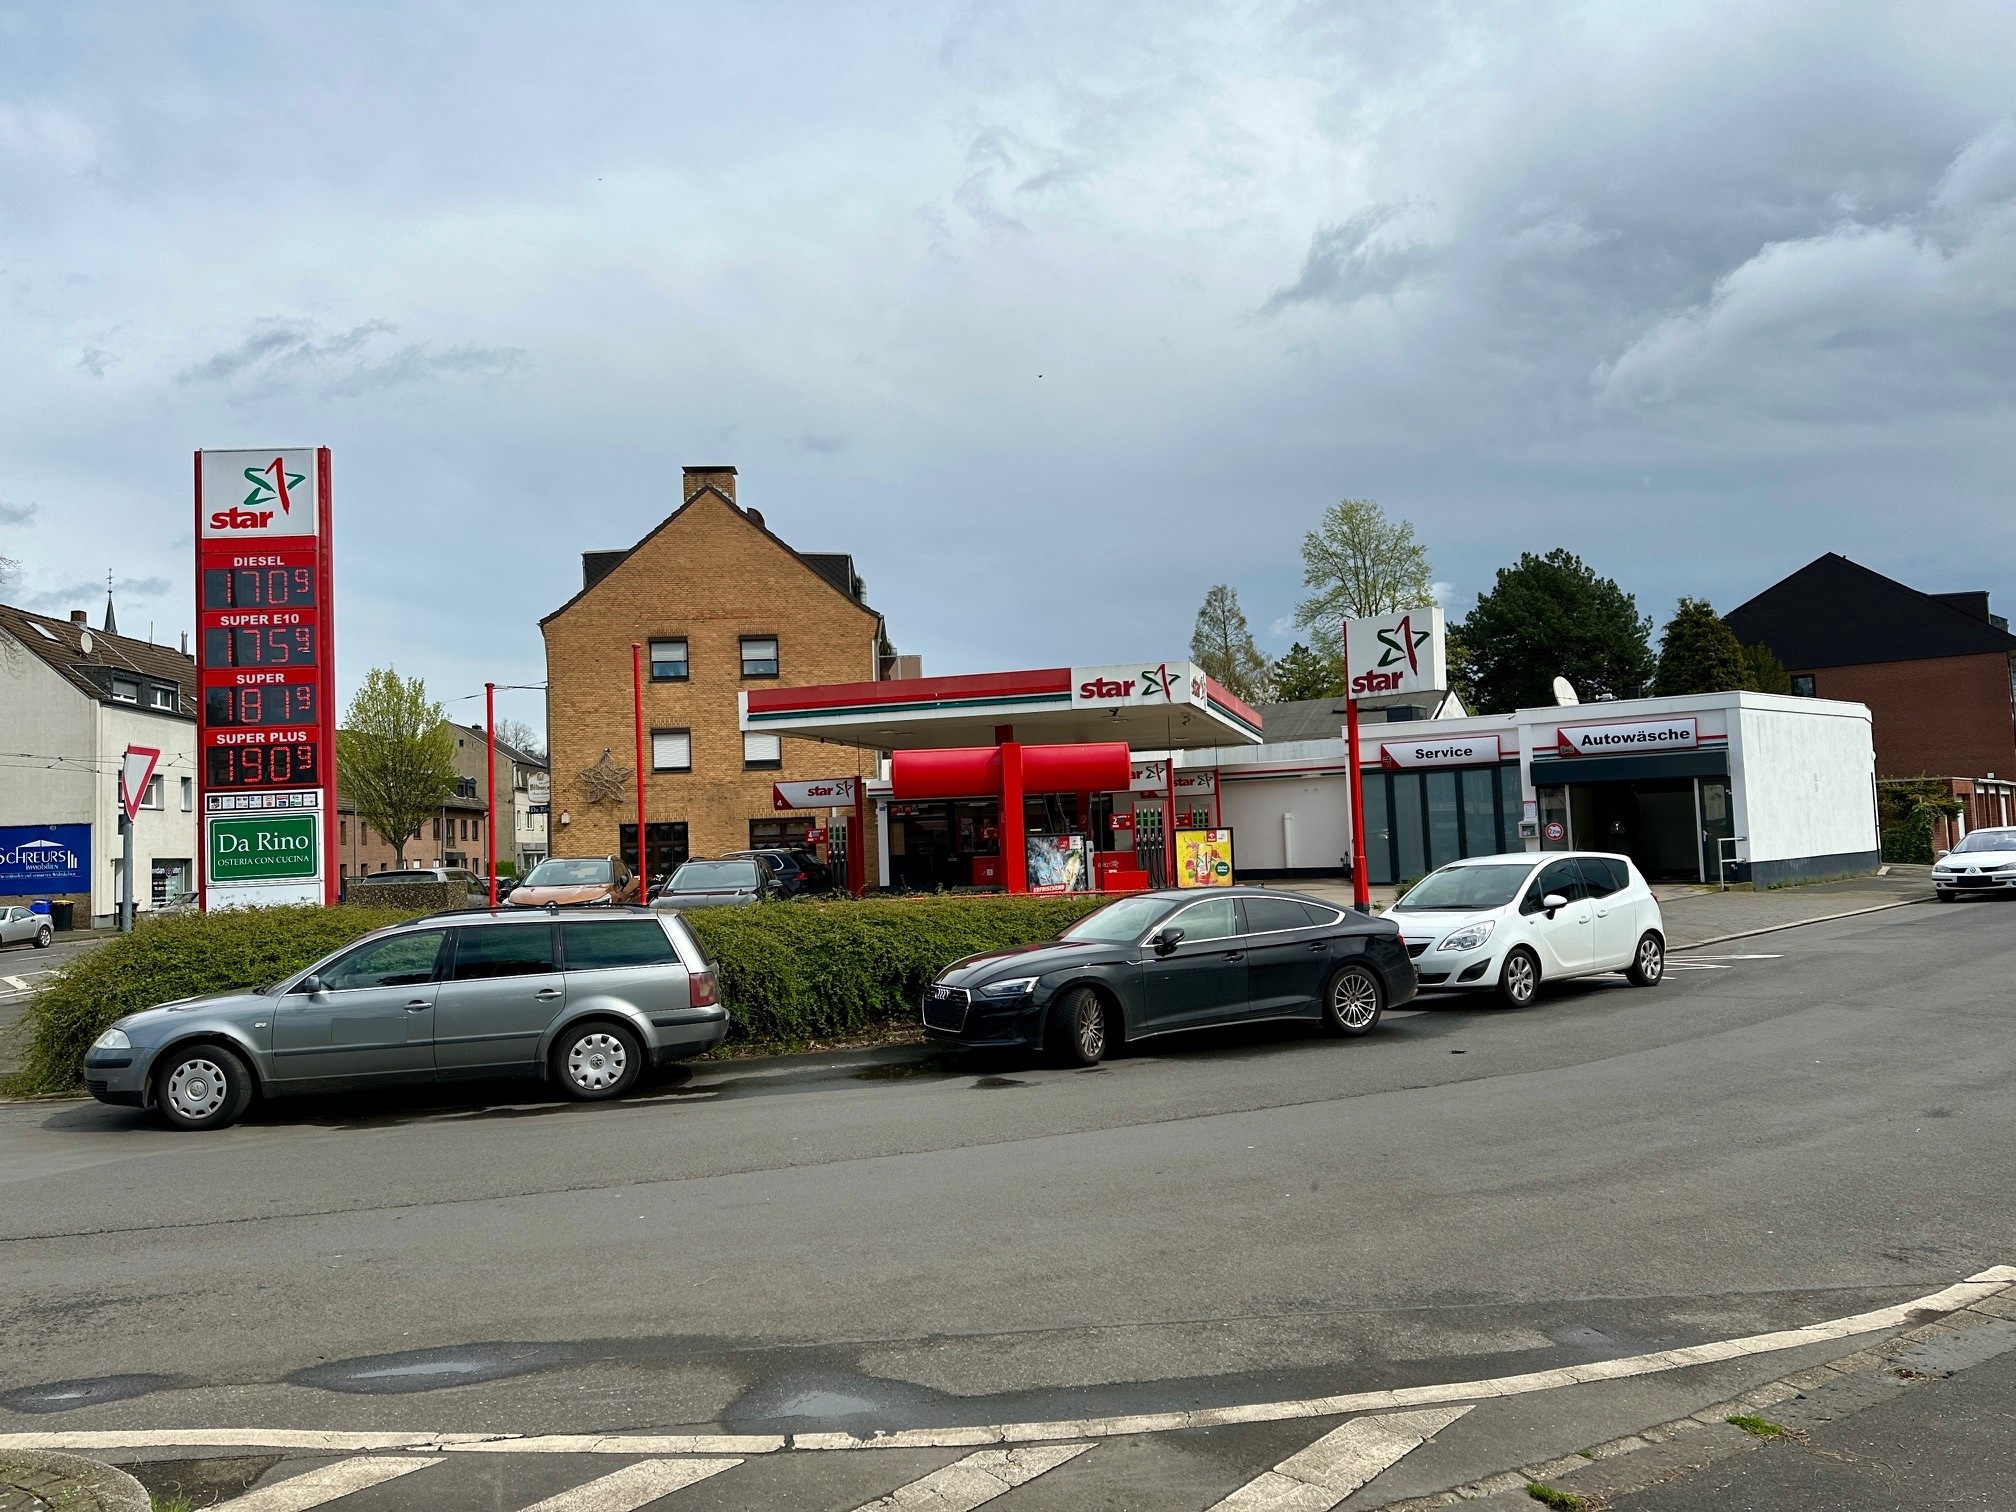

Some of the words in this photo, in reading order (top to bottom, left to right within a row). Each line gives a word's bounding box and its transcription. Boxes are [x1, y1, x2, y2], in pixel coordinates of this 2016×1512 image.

[210, 506, 273, 529] star
[234, 556, 285, 567] DIESEL
[220, 614, 269, 626] SUPER
[273, 613, 300, 624] E10
[236, 673, 285, 684] SUPER
[1351, 669, 1404, 693] star
[1080, 677, 1136, 698] star
[216, 733, 265, 744] SUPER
[270, 731, 307, 742] PLUS
[1581, 729, 1690, 746] Autowäsche
[1415, 747, 1473, 759] Service
[1173, 777, 1195, 787] star
[807, 786, 833, 796] star
[217, 834, 250, 853] Da
[256, 832, 309, 851] Rino
[217, 858, 253, 867] OSTERIA
[254, 856, 275, 864] CON
[275, 855, 310, 863] CUCINA
